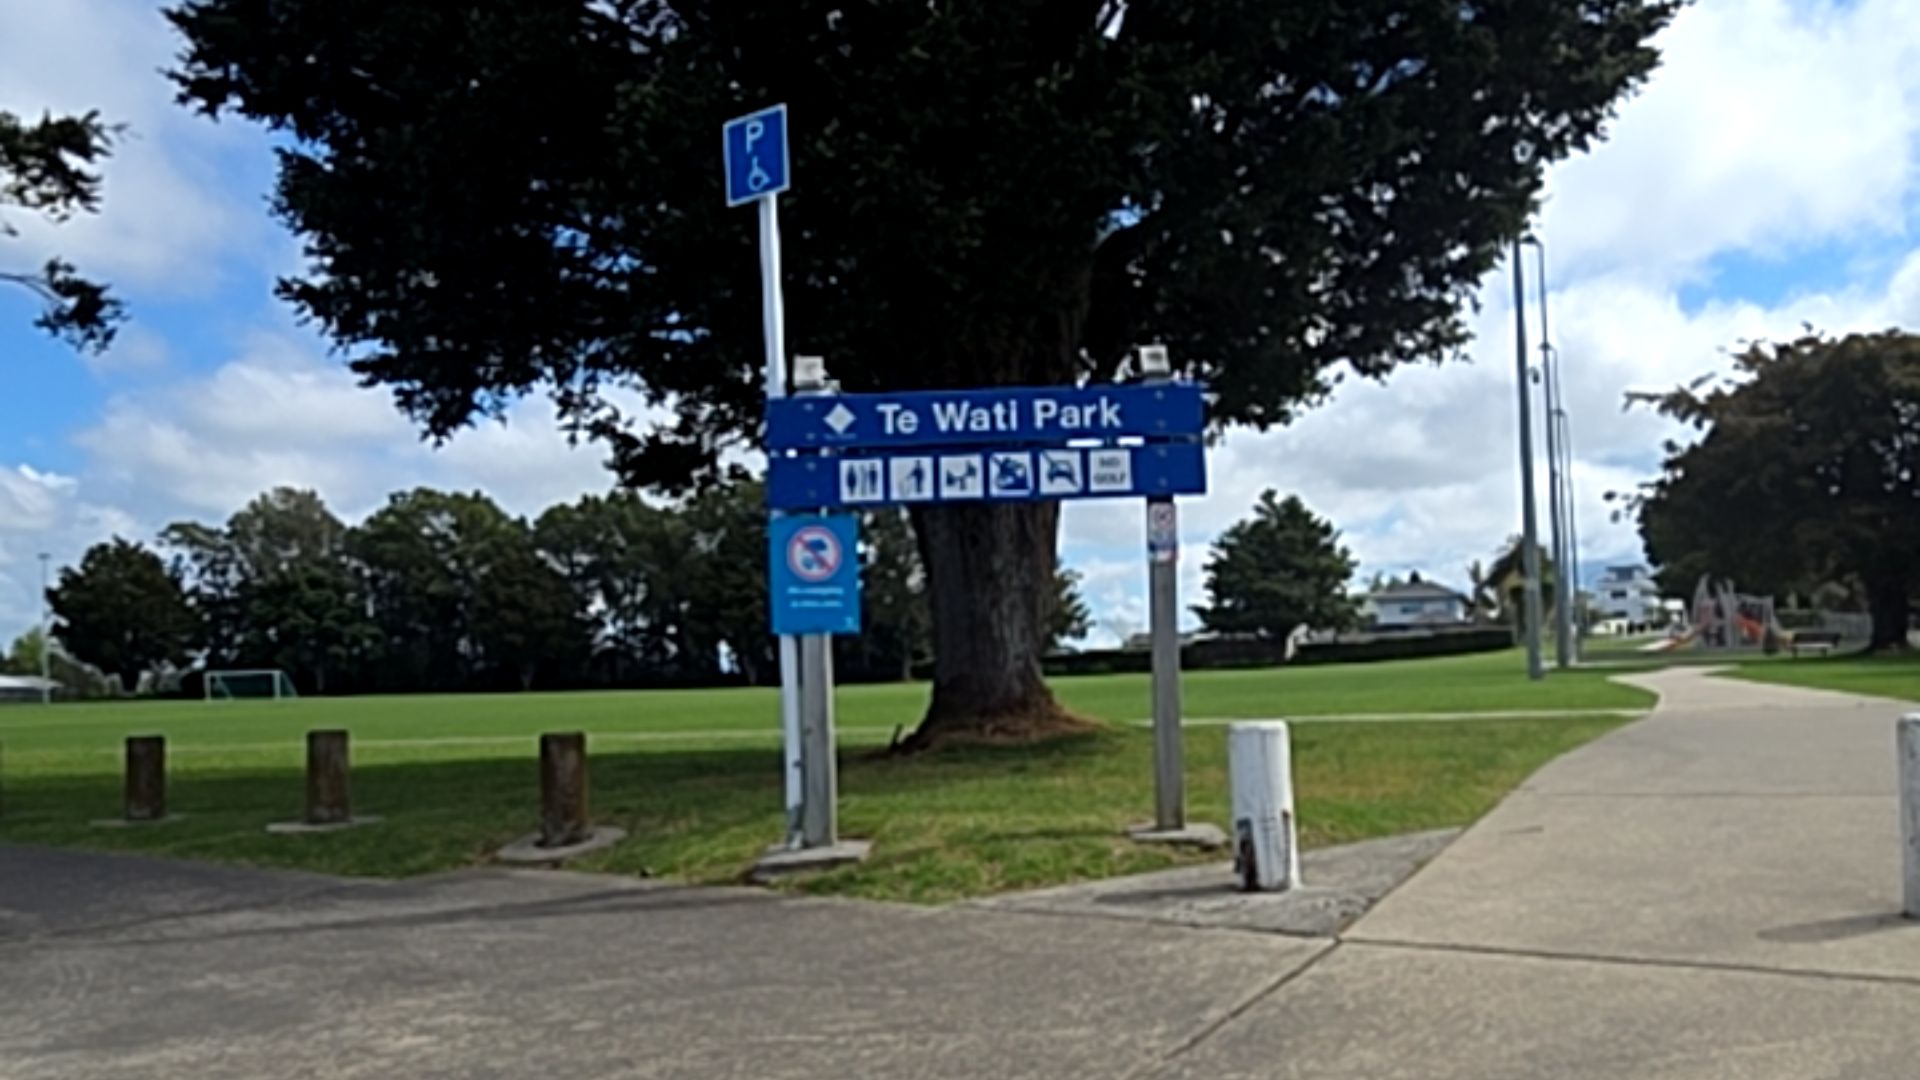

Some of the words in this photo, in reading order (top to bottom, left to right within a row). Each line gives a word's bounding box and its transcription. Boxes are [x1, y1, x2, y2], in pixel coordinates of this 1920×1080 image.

[745, 119, 764, 154] P
[876, 402, 919, 435] Te
[932, 399, 1018, 433] Wati
[1034, 396, 1122, 430] Park
[1093, 472, 1127, 484] GOLF
